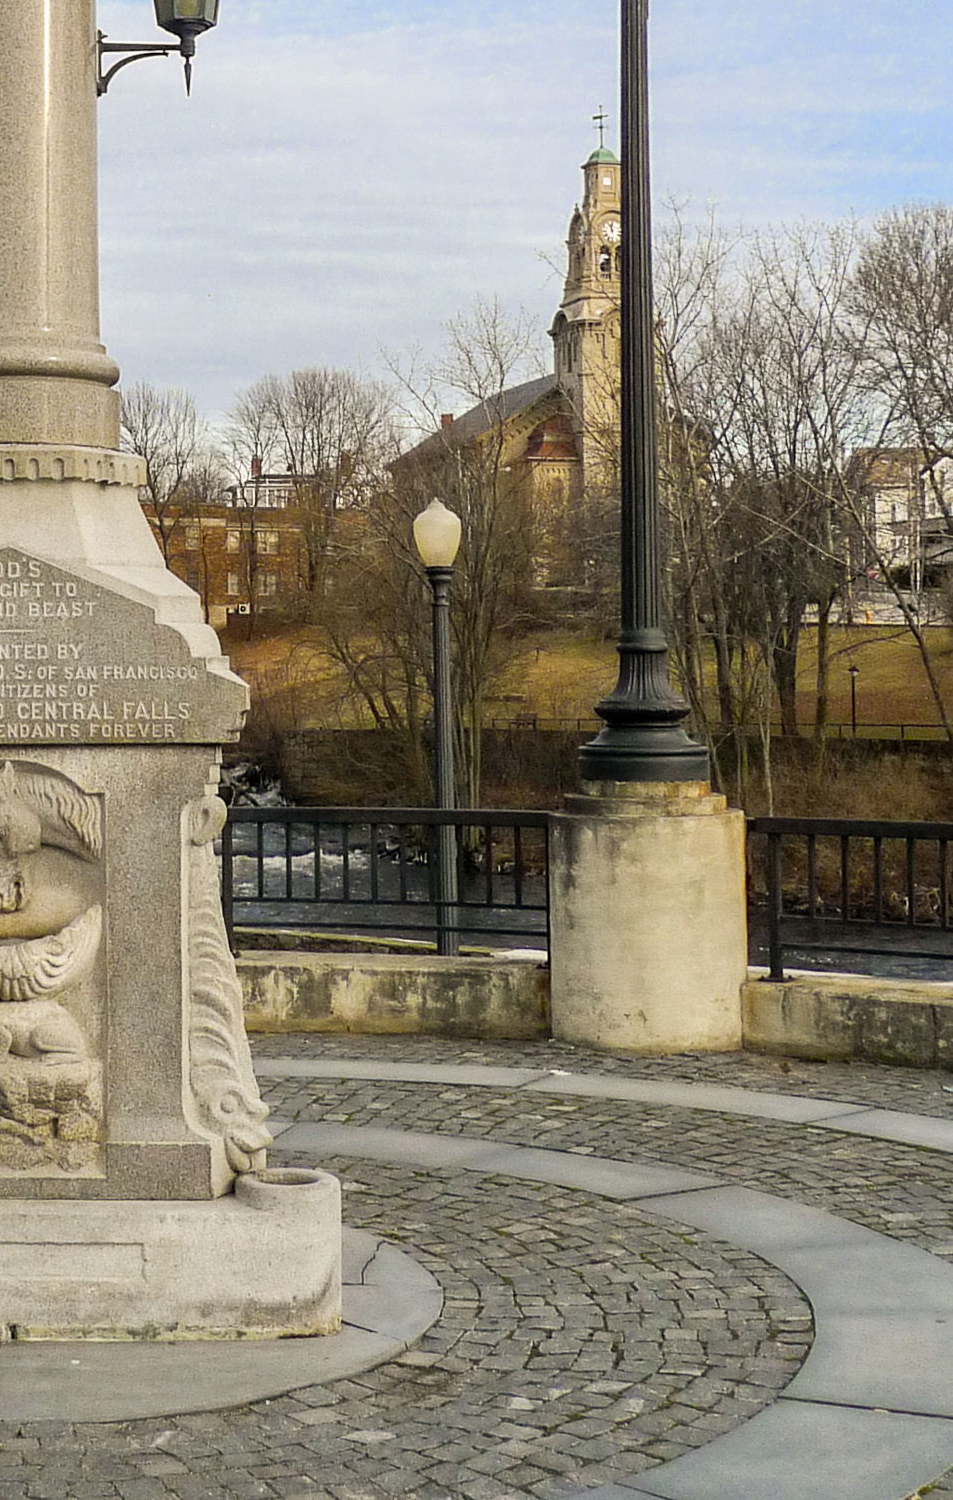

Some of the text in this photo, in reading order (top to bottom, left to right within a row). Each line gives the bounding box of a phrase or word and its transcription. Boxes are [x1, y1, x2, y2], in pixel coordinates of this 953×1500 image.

[0, 581, 45, 598] GIFT
[51, 581, 78, 597] TO
[28, 601, 98, 618] BEAST
[57, 642, 83, 660] BY
[36, 665, 58, 680] OF
[64, 664, 98, 680] SAN
[103, 664, 198, 681] FRANCISCO
[76, 683, 100, 698] OF
[17, 701, 116, 720] CENTRAL
[123, 701, 192, 720] FALLS
[89, 722, 176, 739] FOREVER
